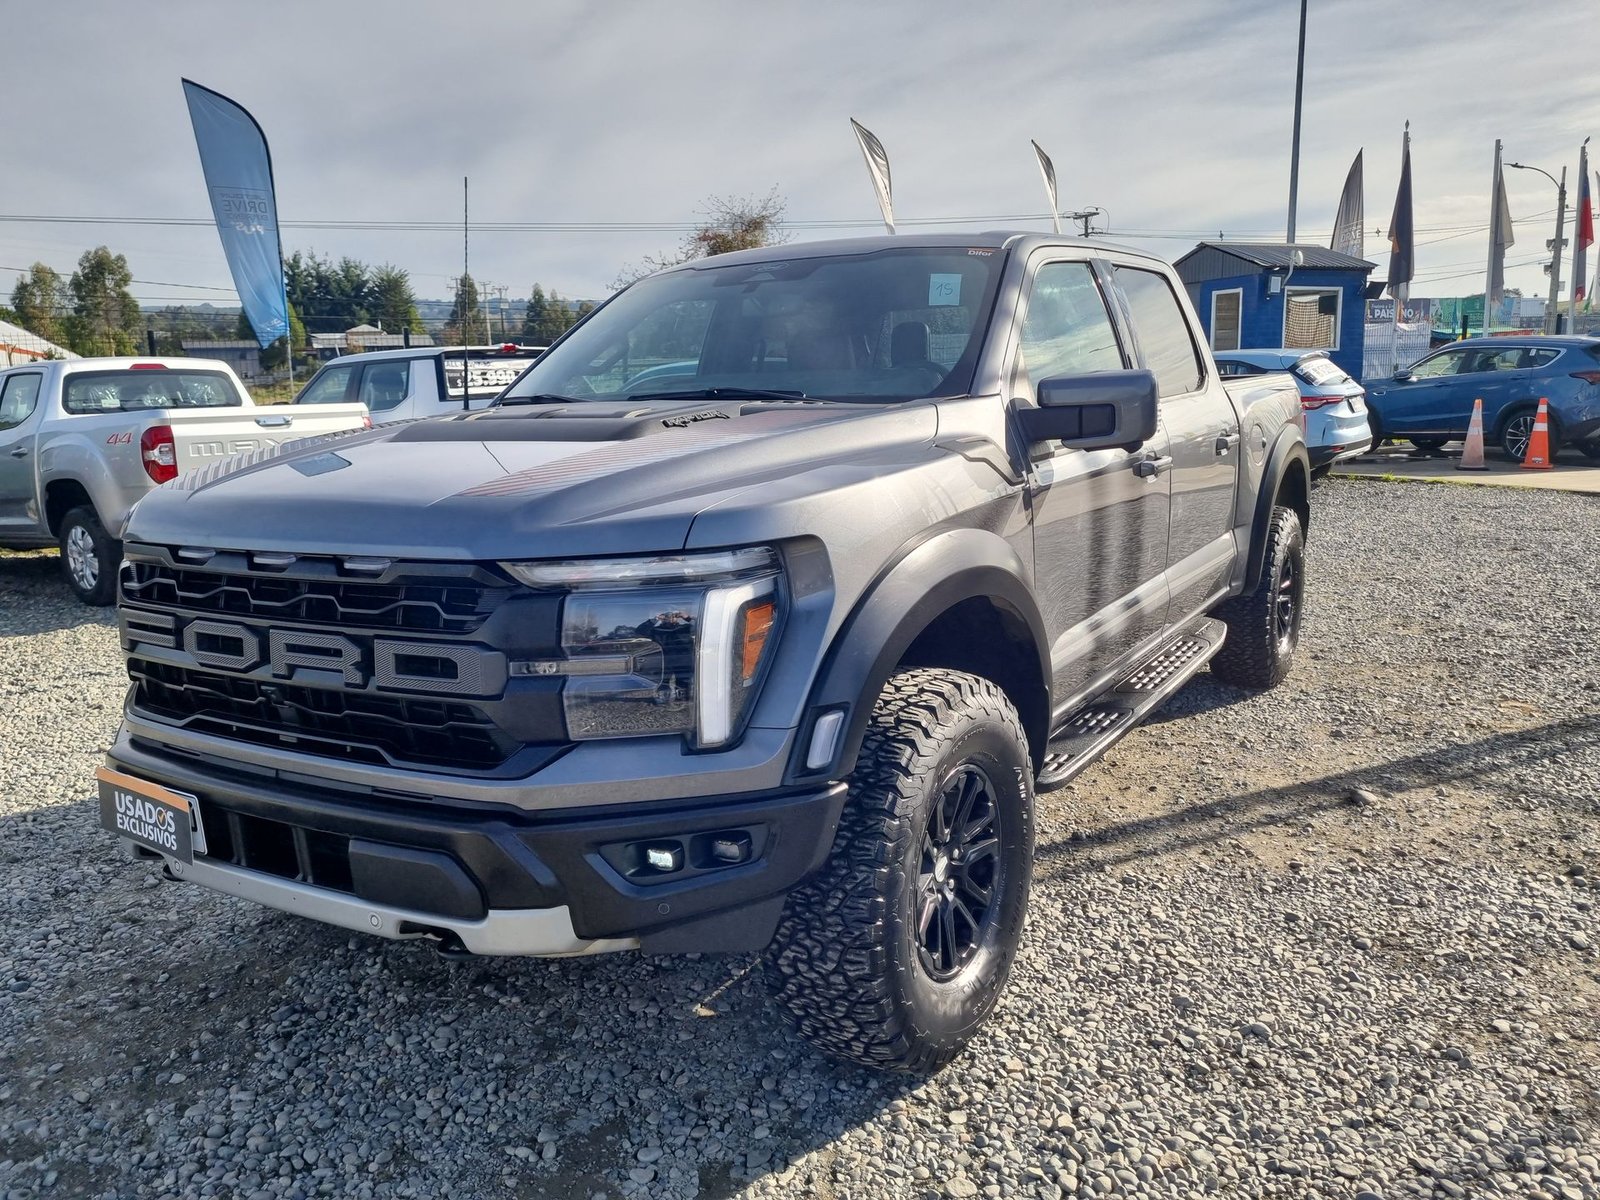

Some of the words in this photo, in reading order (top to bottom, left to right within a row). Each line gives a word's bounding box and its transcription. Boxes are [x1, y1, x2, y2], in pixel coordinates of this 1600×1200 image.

[1374, 308, 1414, 318] PAISNO
[120, 607, 482, 695] FORD
[114, 791, 176, 833] USADOS
[116, 812, 177, 851] EXCLUSIVOS
